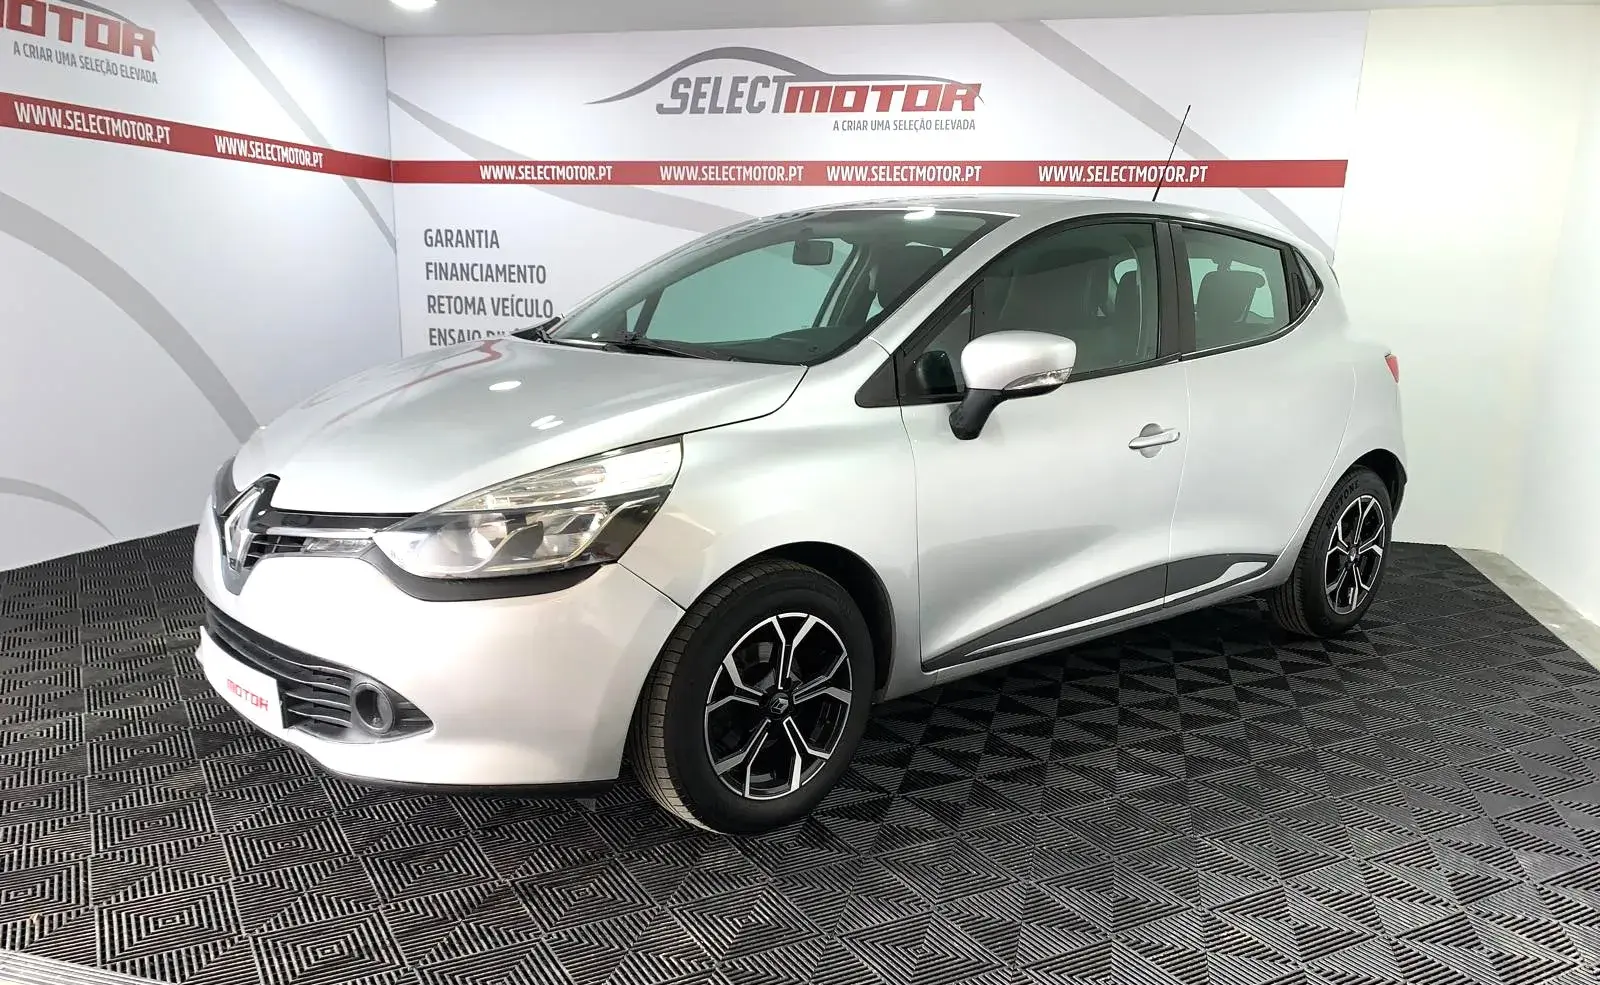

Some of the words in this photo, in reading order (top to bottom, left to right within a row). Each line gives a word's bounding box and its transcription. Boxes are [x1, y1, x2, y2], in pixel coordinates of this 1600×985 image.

[0, 0, 156, 62] OTOR
[13, 41, 21, 56] A
[24, 43, 53, 63] CRIAR
[55, 50, 77, 69] UMA
[79, 55, 118, 76] SELEÇÃO
[120, 64, 158, 84] ELEVADA
[13, 100, 171, 145] WWW.SELECTMOTOR.PT
[832, 120, 839, 131] A
[842, 120, 868, 131] CRIAR
[870, 120, 890, 131] UMA
[893, 118, 932, 132] SELEÇÃO
[934, 119, 976, 131] ELEVADA
[214, 134, 324, 169] WWW.SELECTMOTOR.PT
[479, 165, 613, 181] WWW.SELECTMOTOR.PT
[659, 165, 804, 182] WWW.SELECTMOTOR.PT
[826, 165, 982, 182] WWW.SELECTMOTOR.PT
[1038, 165, 1209, 183] WWW.SELECTMOTOR.PT
[424, 228, 500, 249] GARANTIA
[425, 262, 547, 284] FINANCIAMENTO
[427, 295, 487, 316] RETOMA
[491, 294, 553, 319] VEÍCULO
